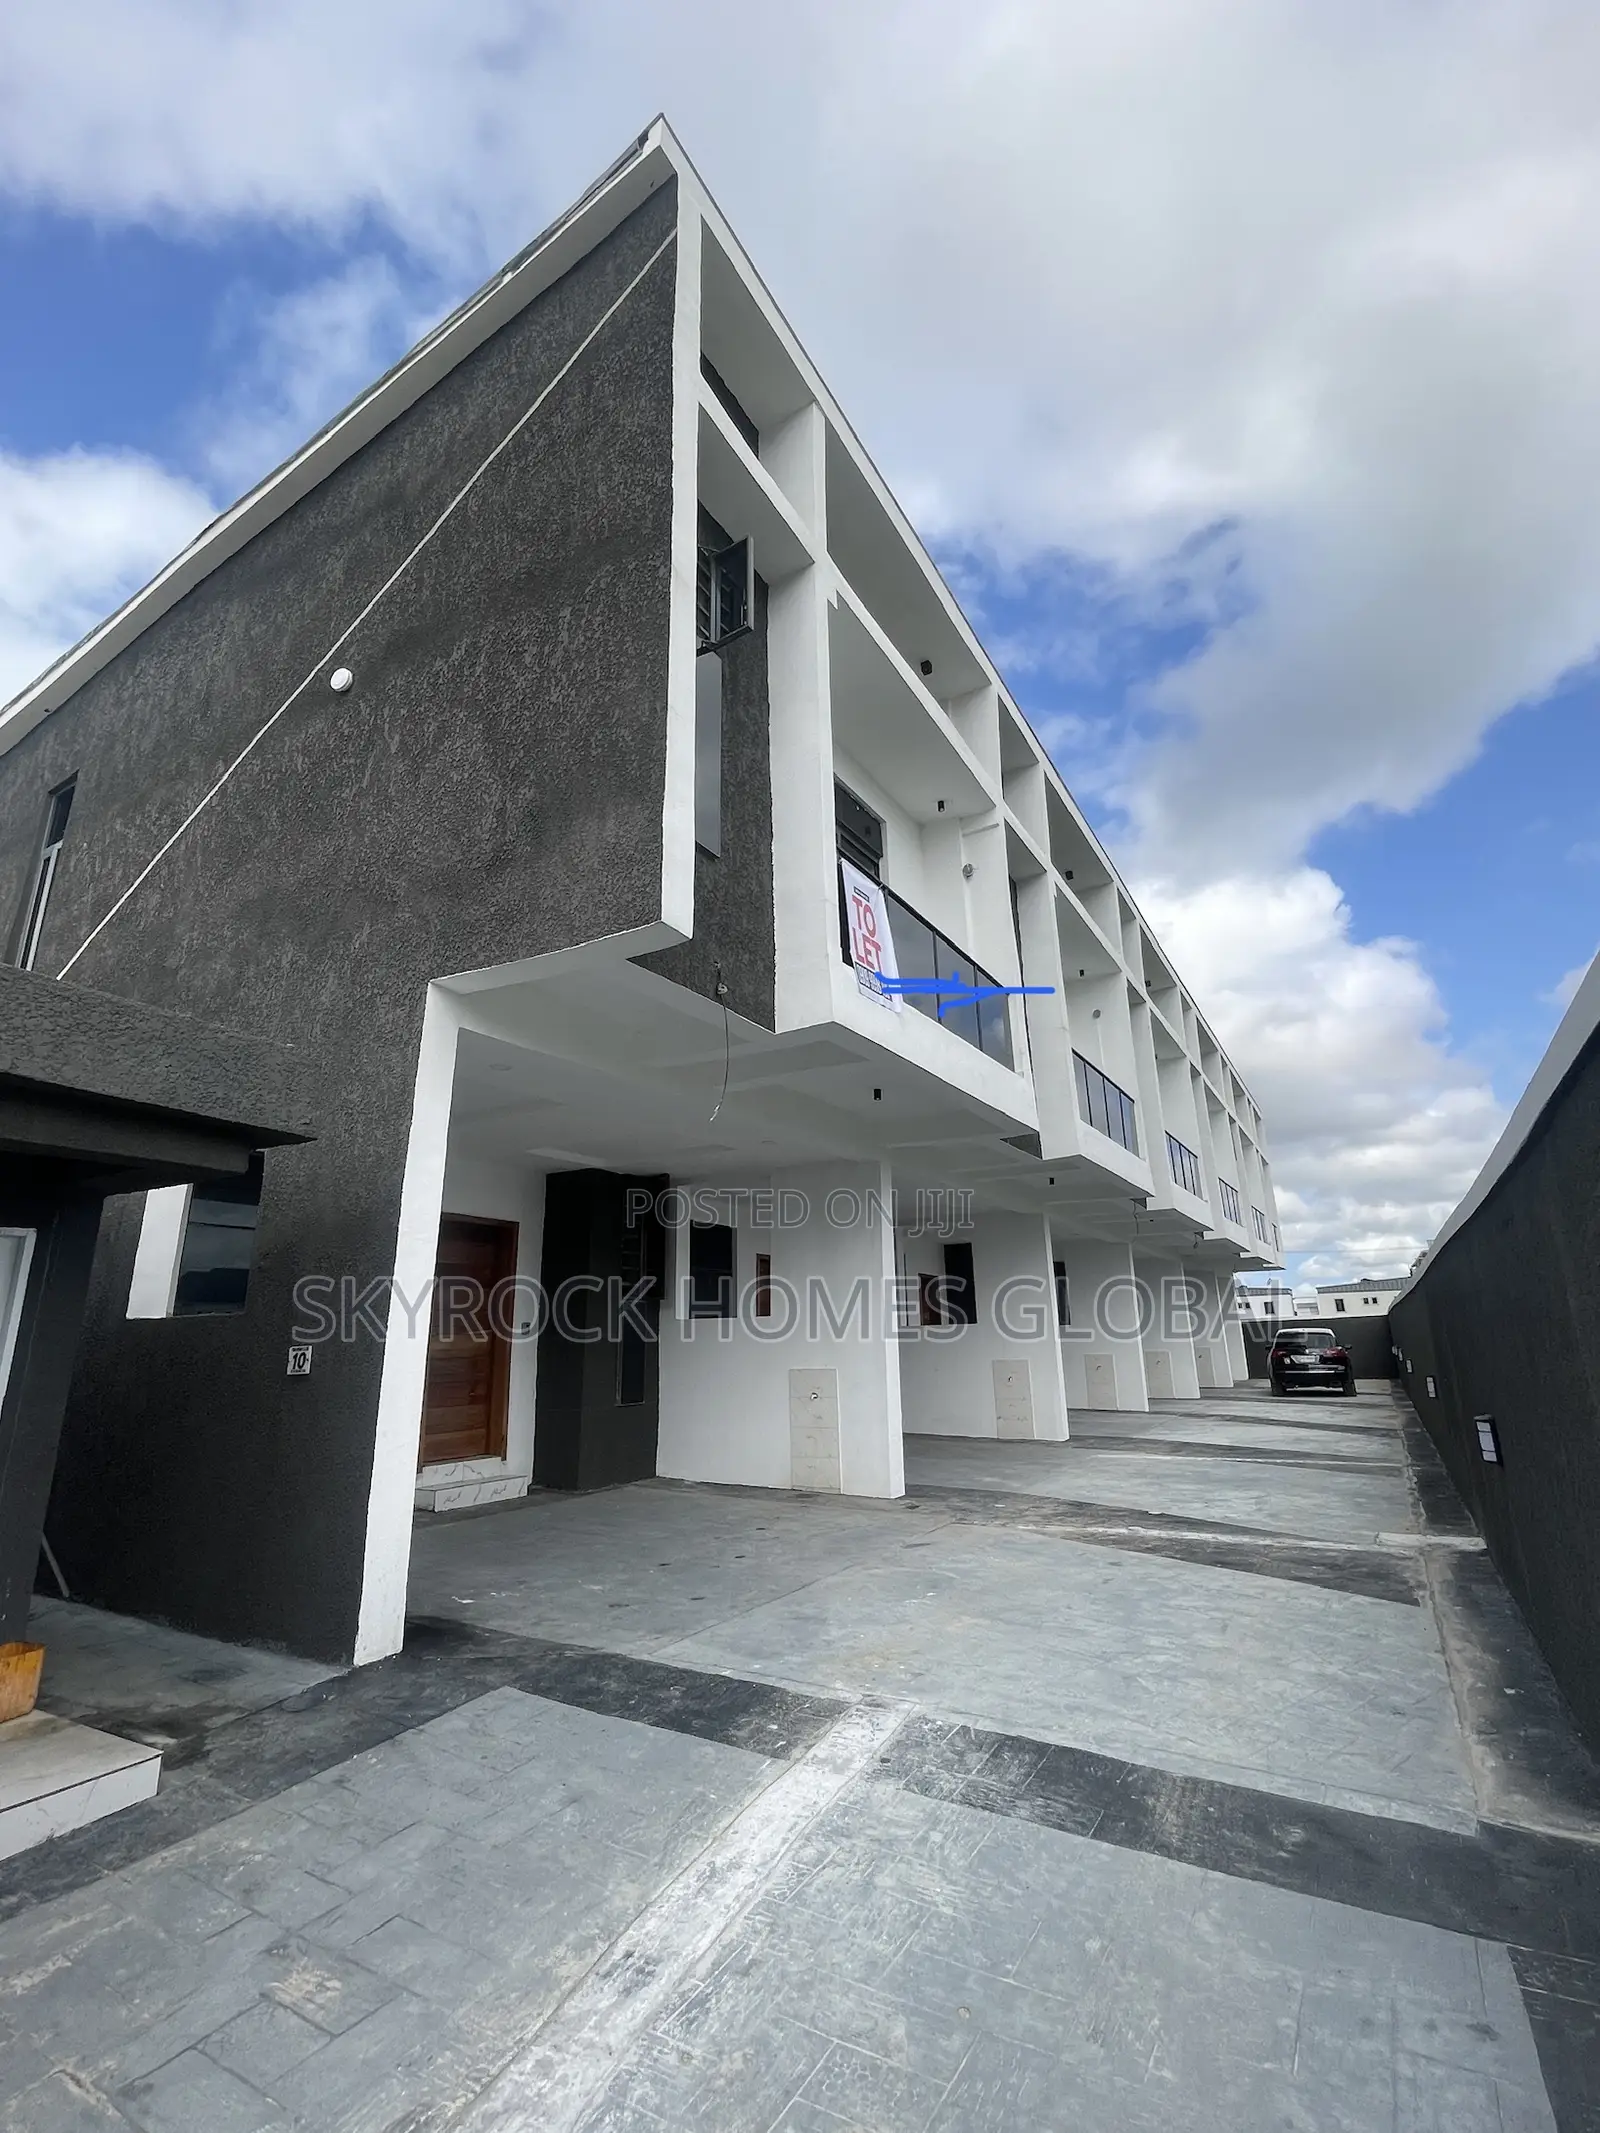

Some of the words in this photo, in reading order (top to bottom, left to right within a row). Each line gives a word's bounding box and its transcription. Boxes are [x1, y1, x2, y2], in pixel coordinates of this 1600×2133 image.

[852, 895, 876, 938] TO
[853, 927, 882, 975] LET
[292, 1352, 306, 1370] 10
